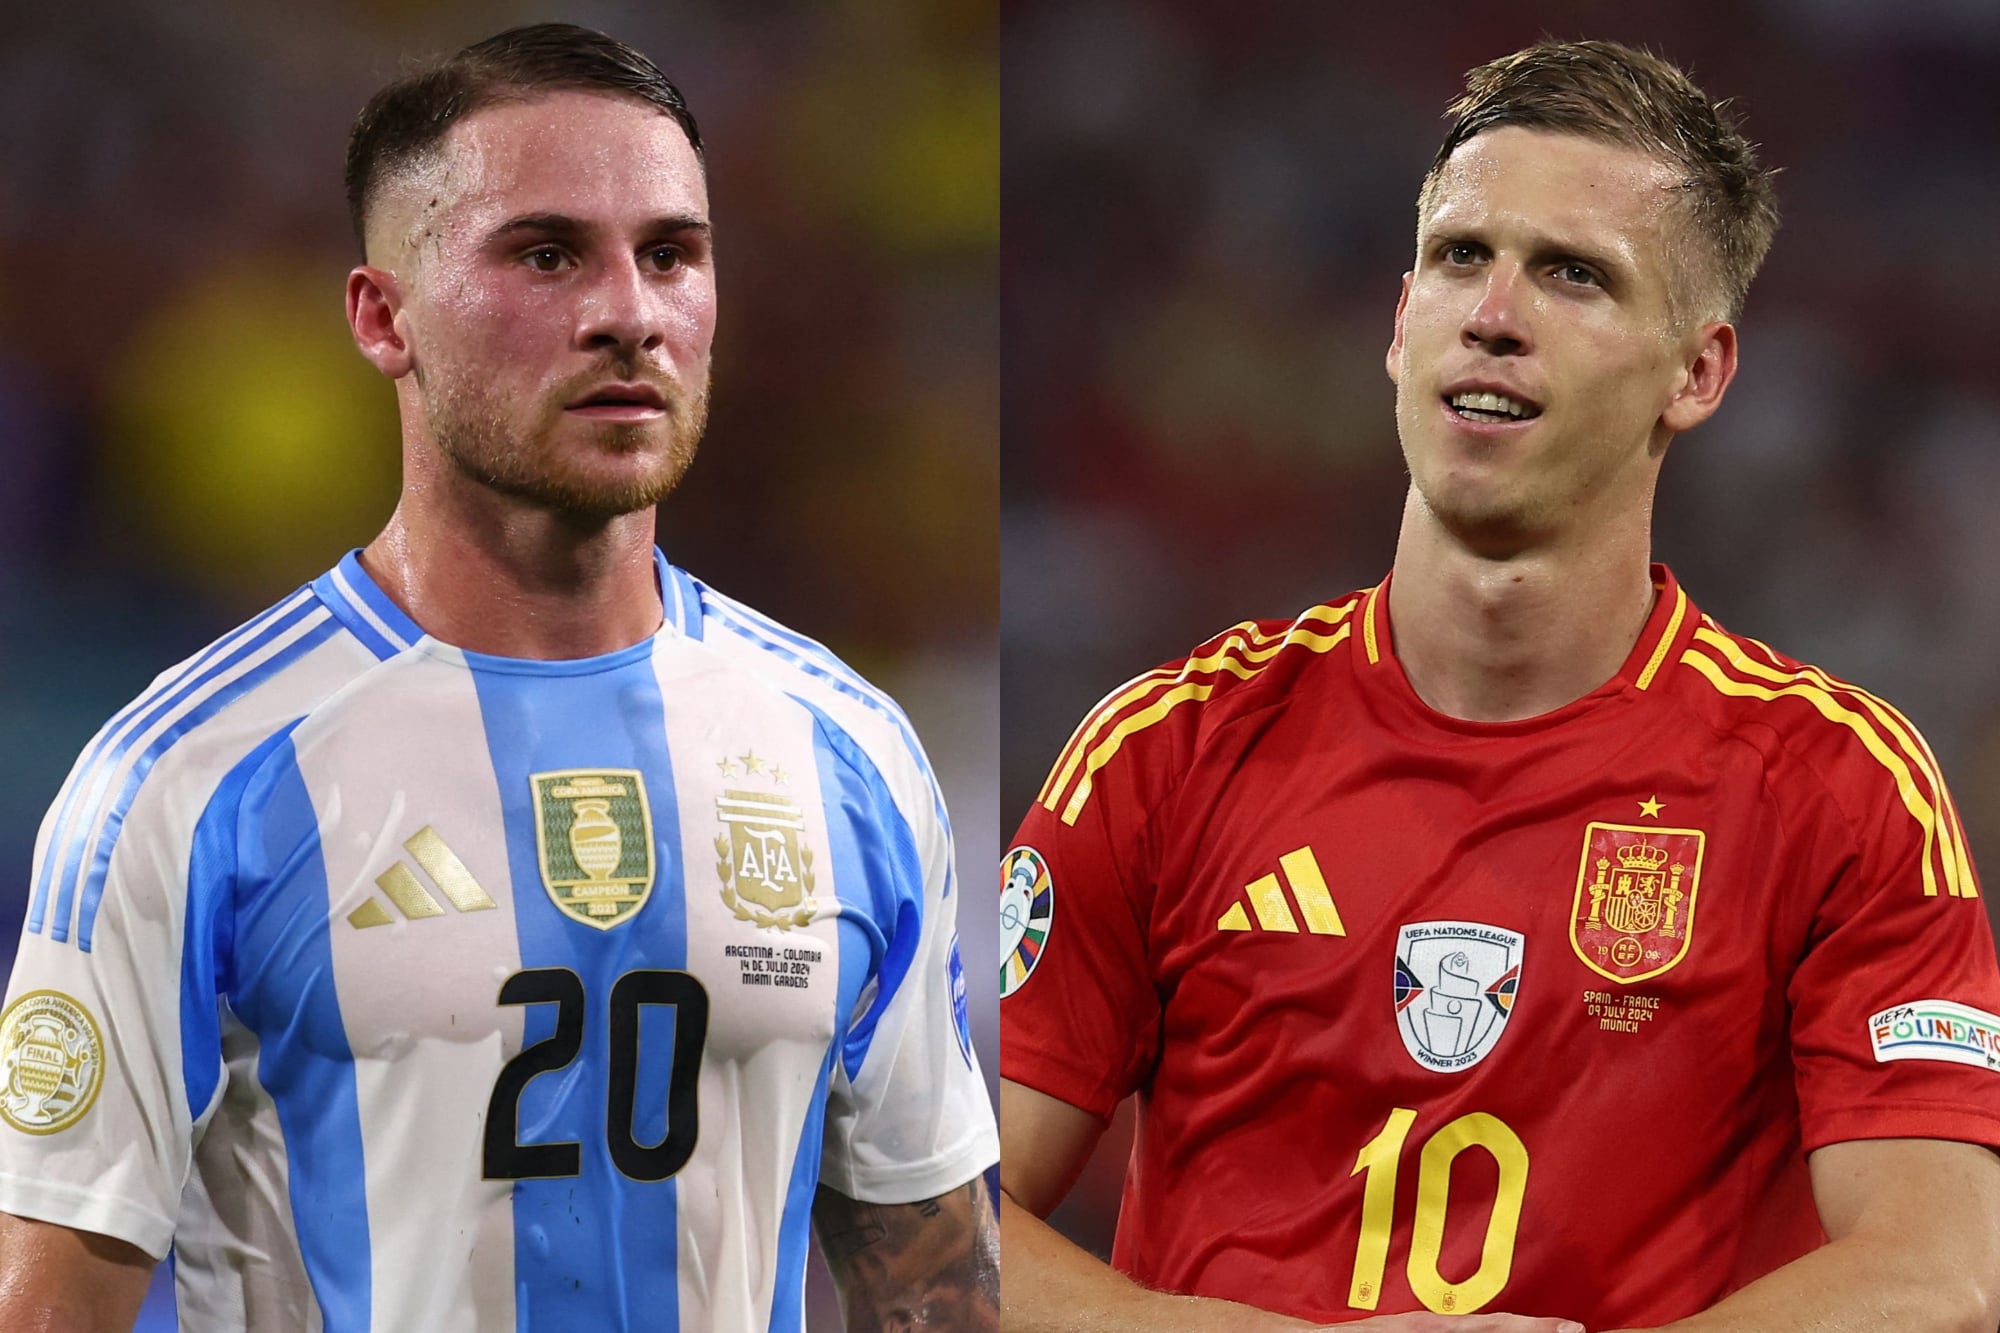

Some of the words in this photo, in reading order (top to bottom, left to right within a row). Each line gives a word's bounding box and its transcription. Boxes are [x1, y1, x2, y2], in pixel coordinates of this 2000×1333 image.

[739, 825, 798, 892] AFA
[1405, 928, 1431, 939] UEFA
[1433, 927, 1477, 937] NATIONS
[1479, 929, 1517, 946] LEAGUE
[725, 945, 773, 959] ARGENTINA
[783, 948, 821, 963] COLOMBIA
[740, 960, 750, 971] 14
[752, 960, 764, 972] DE
[766, 960, 788, 974] JULIO
[790, 962, 810, 975] 2024
[742, 973, 772, 986] MIAMI
[774, 974, 809, 989] GARDENS
[1583, 990, 1612, 1005] SPAIN
[1622, 995, 1660, 1009] FRANCE
[1588, 1004, 1601, 1017] 09
[1602, 1005, 1626, 1019] JULY
[1627, 1008, 1653, 1022] 2024
[1874, 1007, 1915, 1027] UEFA
[1600, 1018, 1639, 1034] MUNICH
[26, 1046, 60, 1063] FINAL
[1417, 1048, 1453, 1068] WINNER
[1454, 1051, 1478, 1067] 2023
[481, 966, 710, 1183] 20
[1347, 1107, 1530, 1316] 10
